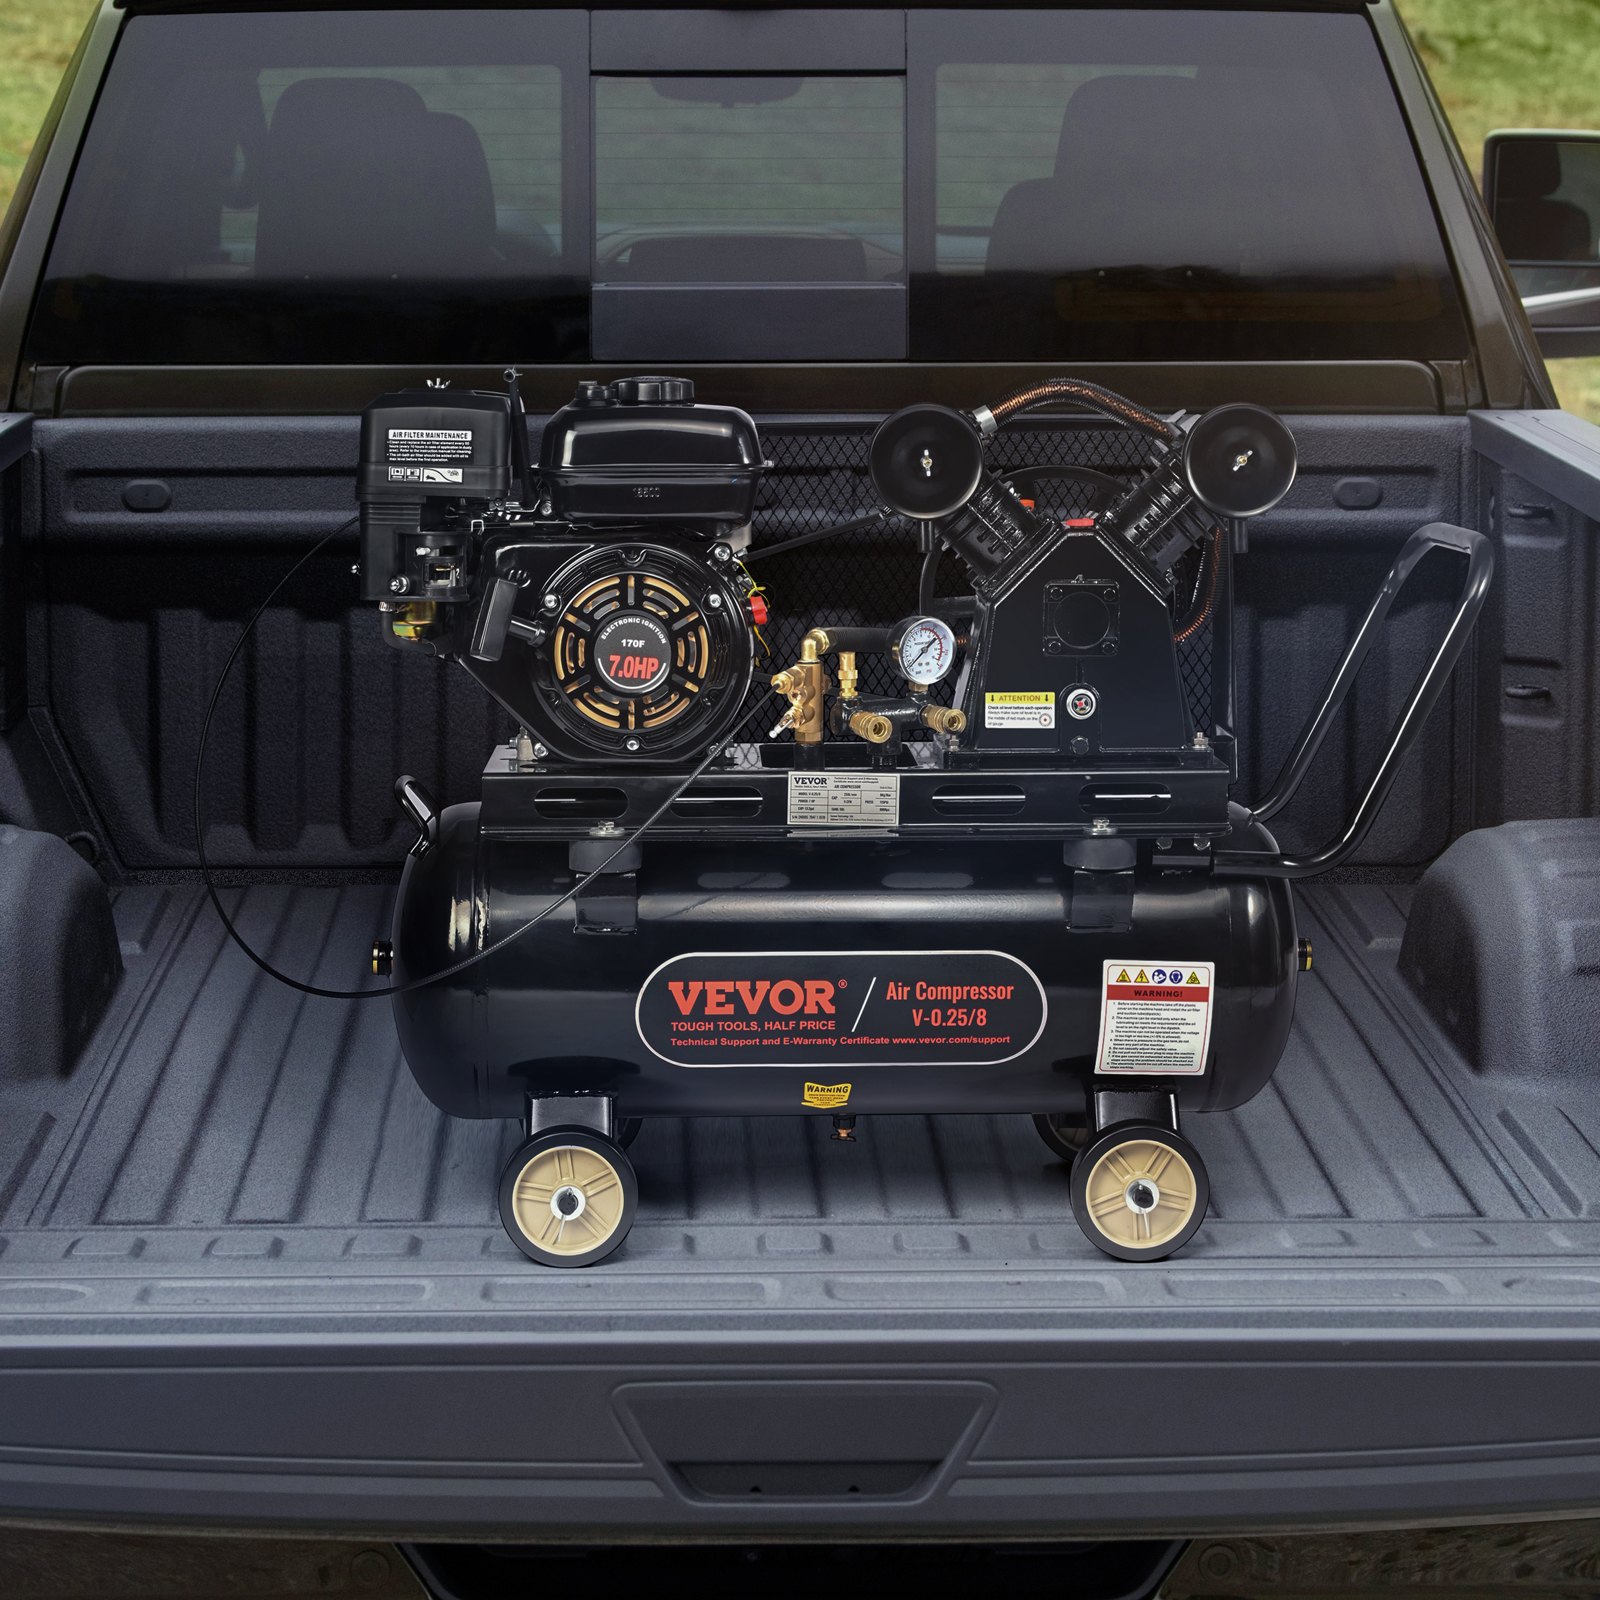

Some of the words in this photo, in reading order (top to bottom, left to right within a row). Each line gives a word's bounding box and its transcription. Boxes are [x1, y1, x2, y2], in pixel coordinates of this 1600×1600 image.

[601, 618, 640, 640] ELECTRONIC
[642, 620, 666, 643] IGNITION
[621, 639, 645, 648] 170F
[609, 654, 659, 679] 7.0HP
[886, 982, 910, 1000] Air
[916, 982, 1014, 1003] Compressor
[912, 1008, 986, 1026] V-0.25/8
[671, 1022, 714, 1031] TOUGH
[717, 1021, 761, 1032] TOOLS,
[765, 1021, 796, 1030] HALF
[800, 1020, 836, 1030] PRICE
[671, 1038, 717, 1046] Technical
[721, 1038, 759, 1047] Support
[783, 1037, 837, 1046] E-Warranty
[840, 1036, 889, 1044] Certificate
[892, 1036, 1010, 1045] www.vevor.com/support
[807, 1085, 848, 1093] WARNING
